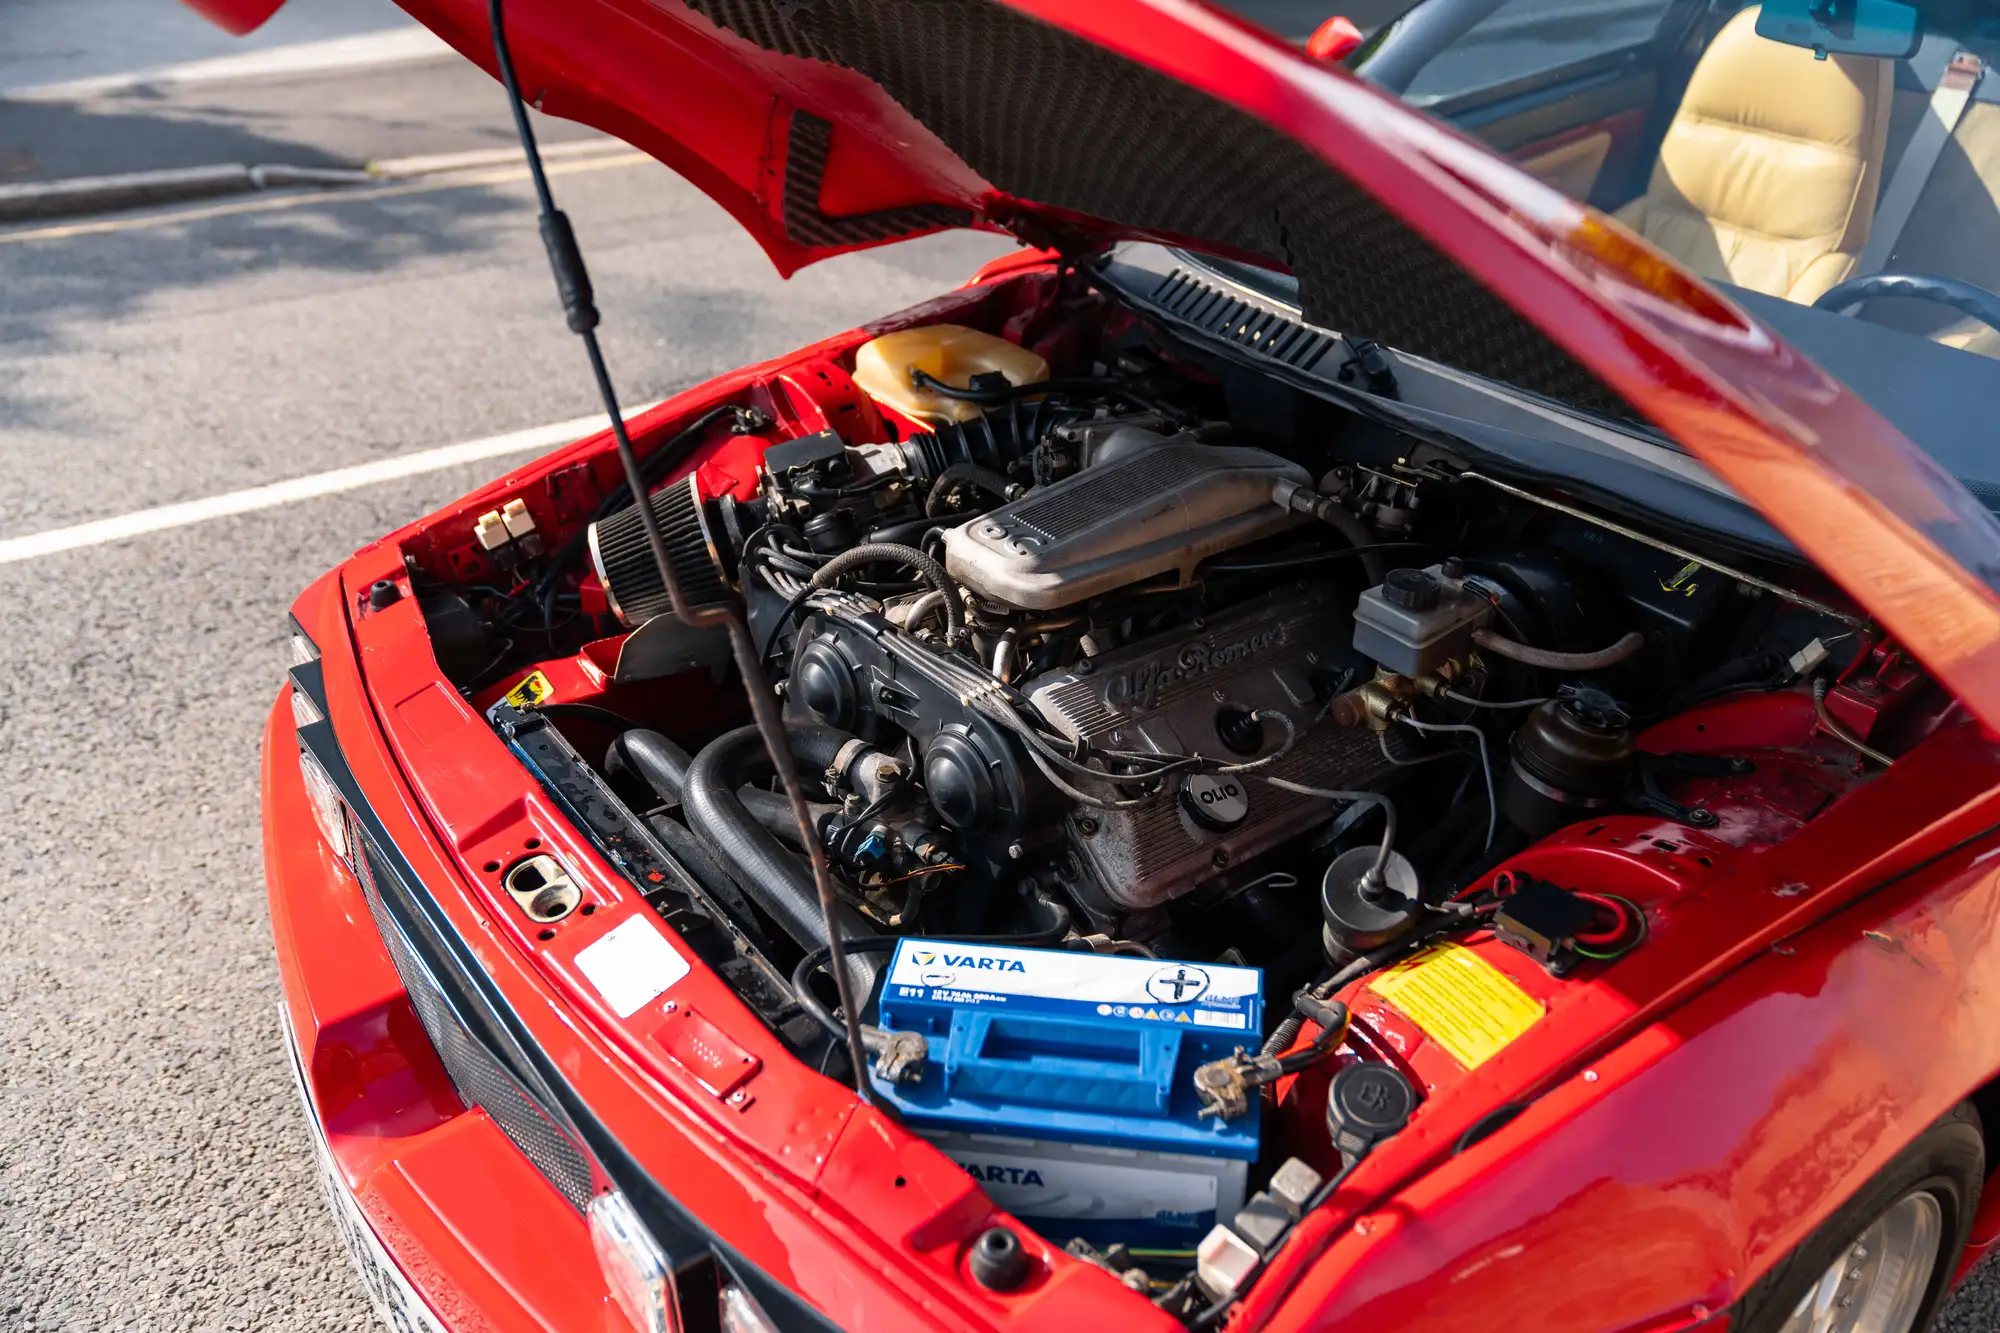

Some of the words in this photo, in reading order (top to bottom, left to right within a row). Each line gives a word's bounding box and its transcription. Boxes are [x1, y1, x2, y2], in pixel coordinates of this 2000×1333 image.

[1104, 661, 1182, 712] Alfa
[1176, 628, 1276, 679] Romeo
[1200, 784, 1239, 804] OLIO
[943, 954, 1026, 973] VARTA
[899, 986, 924, 998] E11
[958, 1162, 1045, 1188] ARTA
